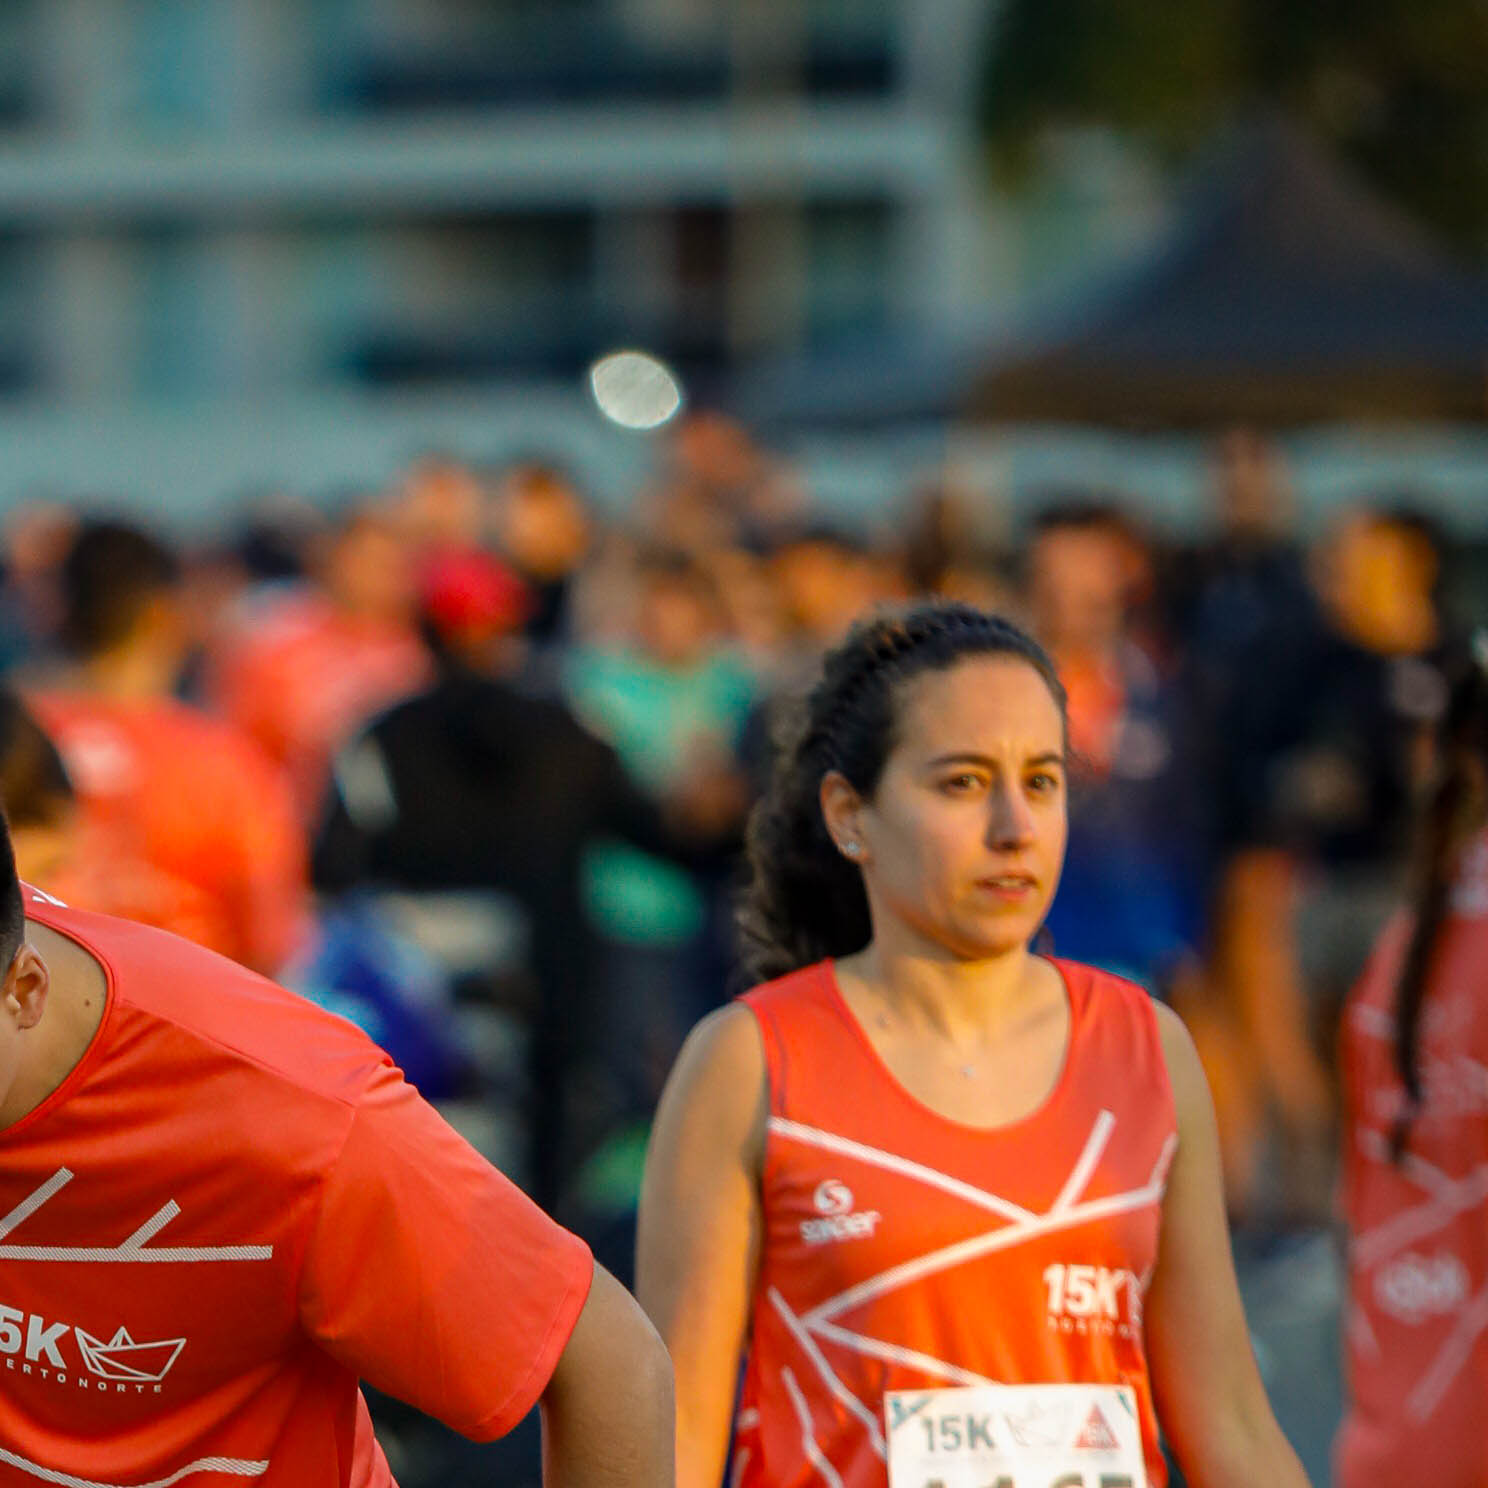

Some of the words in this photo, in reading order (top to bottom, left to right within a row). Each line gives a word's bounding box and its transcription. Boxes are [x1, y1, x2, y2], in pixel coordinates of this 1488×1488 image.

[1043, 1264, 1127, 1321] 15K
[78, 1377, 162, 1393] NORTE
[922, 1415, 996, 1452] 15K
